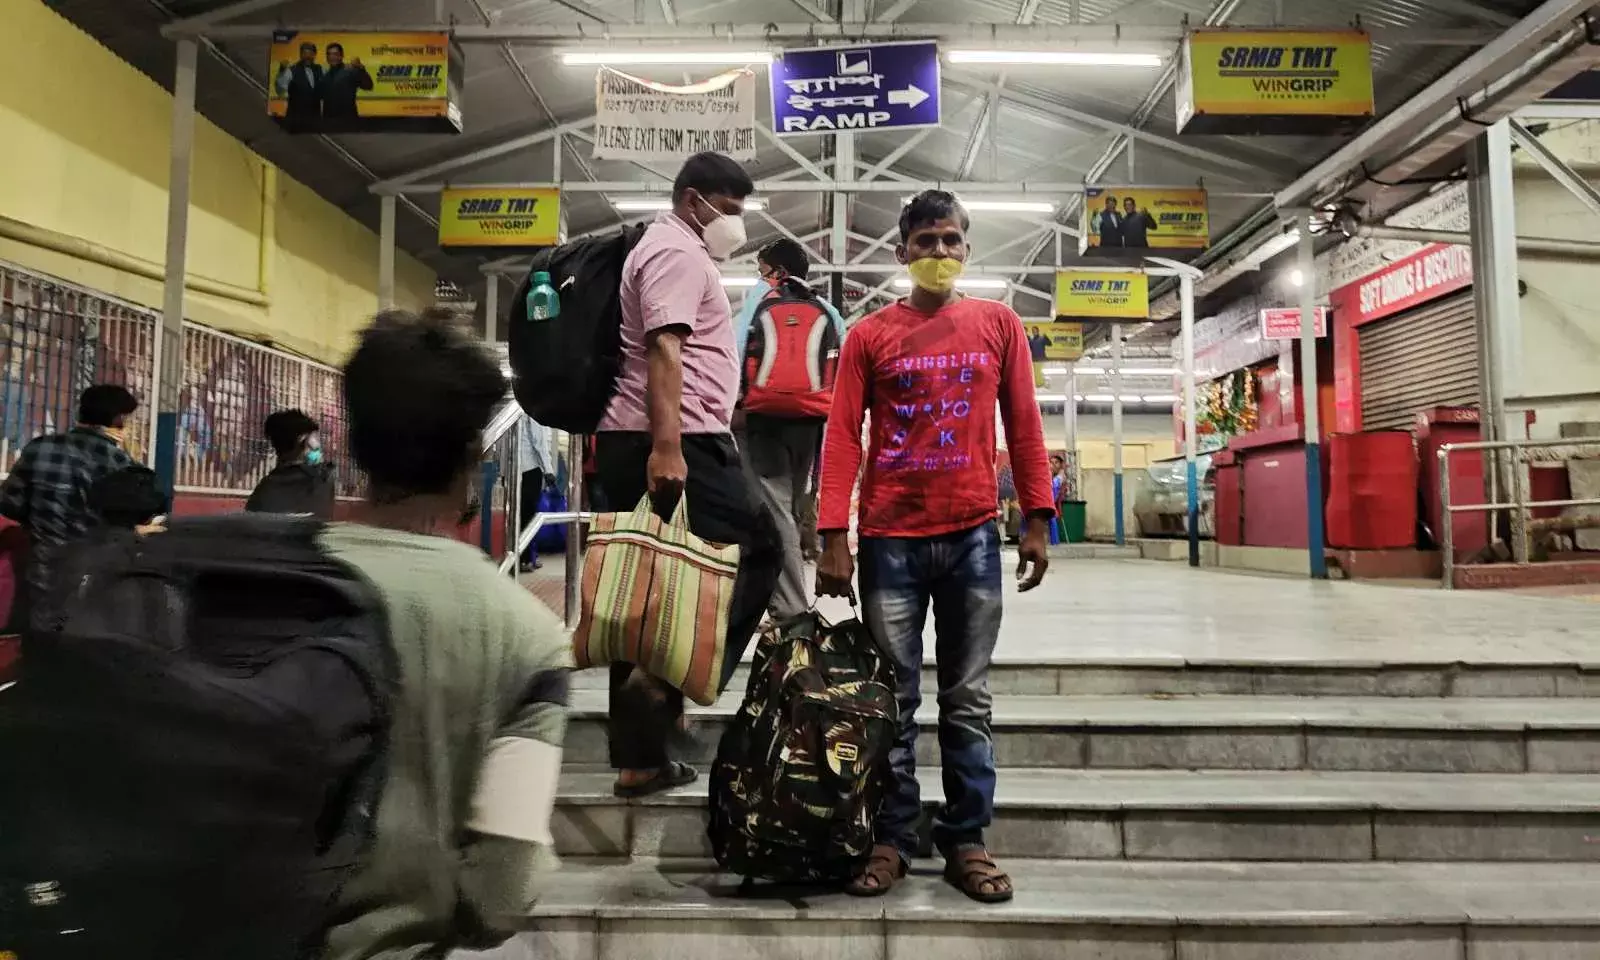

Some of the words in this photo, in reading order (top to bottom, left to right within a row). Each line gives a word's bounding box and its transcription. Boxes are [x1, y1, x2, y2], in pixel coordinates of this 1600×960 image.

[1219, 46, 1285, 68] SRMB
[1290, 47, 1338, 68] TMT
[377, 65, 413, 76] SRMB
[418, 64, 442, 76] TMT
[1252, 79, 1334, 92] WINGRIP
[783, 112, 891, 131] RAMP
[599, 125, 632, 149] PLEASE
[634, 128, 655, 152] EXIT
[659, 127, 684, 152] FROM
[686, 129, 710, 152] THIS
[457, 198, 503, 213] SRMB
[507, 198, 538, 213] TMT
[479, 220, 534, 229] WINGRIP
[1070, 280, 1103, 291] SRMB
[1107, 280, 1131, 291] TMT
[1359, 278, 1381, 314] SOFT
[1381, 263, 1414, 306] DRINKS
[1415, 259, 1424, 292] &
[1423, 245, 1473, 289] BISCUITS
